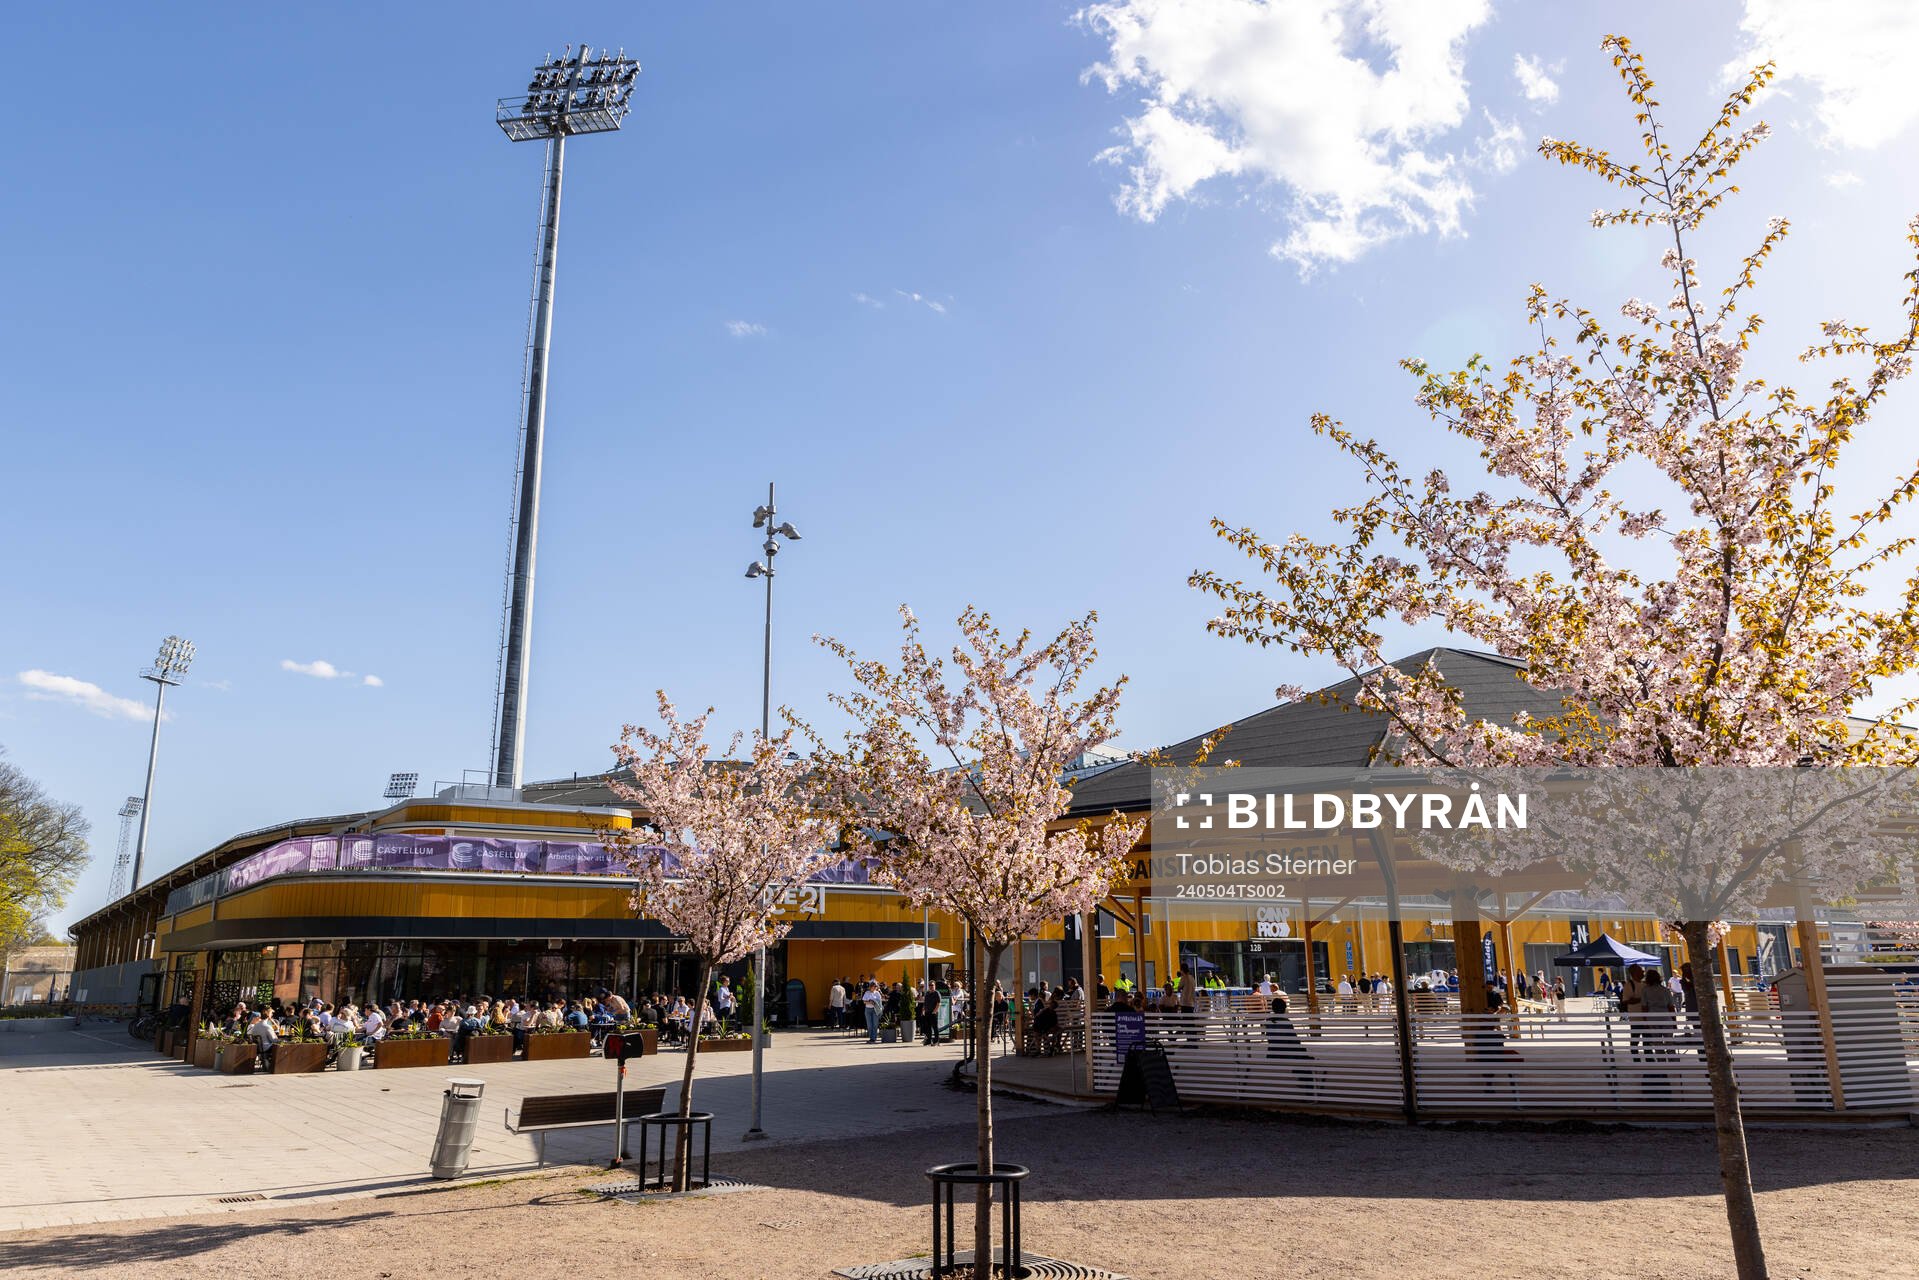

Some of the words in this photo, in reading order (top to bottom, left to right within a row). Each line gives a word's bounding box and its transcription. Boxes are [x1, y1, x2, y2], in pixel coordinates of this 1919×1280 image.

[377, 845, 434, 856] CASTELLUM
[476, 847, 527, 860] CASTELLUM
[673, 942, 693, 953] 12A
[1250, 944, 1262, 952] 12B
